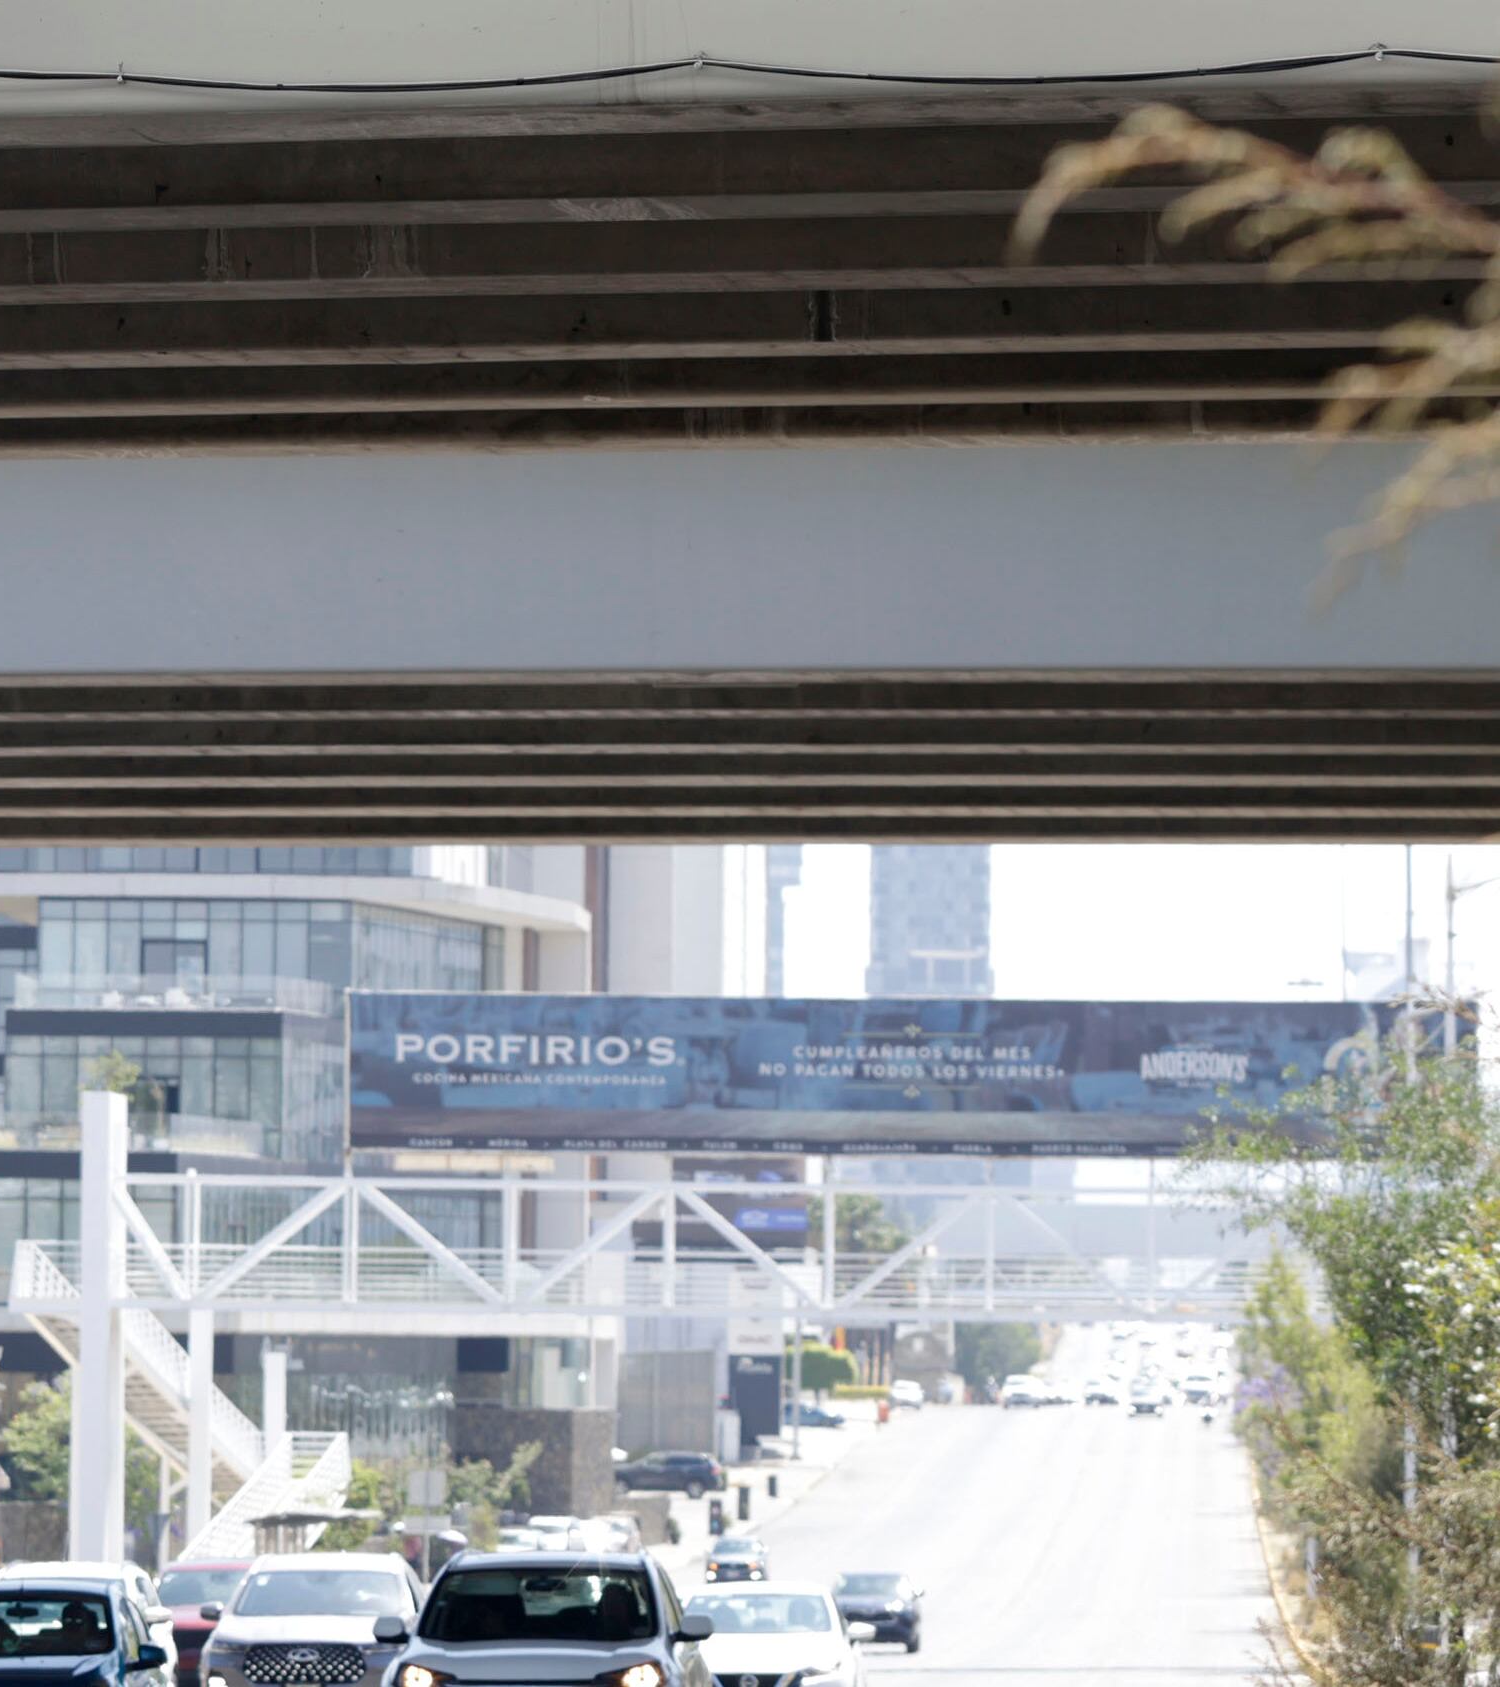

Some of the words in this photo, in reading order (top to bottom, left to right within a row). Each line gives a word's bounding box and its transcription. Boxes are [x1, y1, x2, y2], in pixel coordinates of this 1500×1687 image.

[395, 1033, 677, 1066] PORFIRIO'S
[953, 1046, 985, 1061] DEL
[993, 1046, 1031, 1060] MES
[412, 1072, 468, 1085] COCINA
[470, 1072, 541, 1085] MEXICANA
[758, 1062, 787, 1076] NO
[862, 1063, 925, 1079] TODOS
[932, 1064, 969, 1079] LOS
